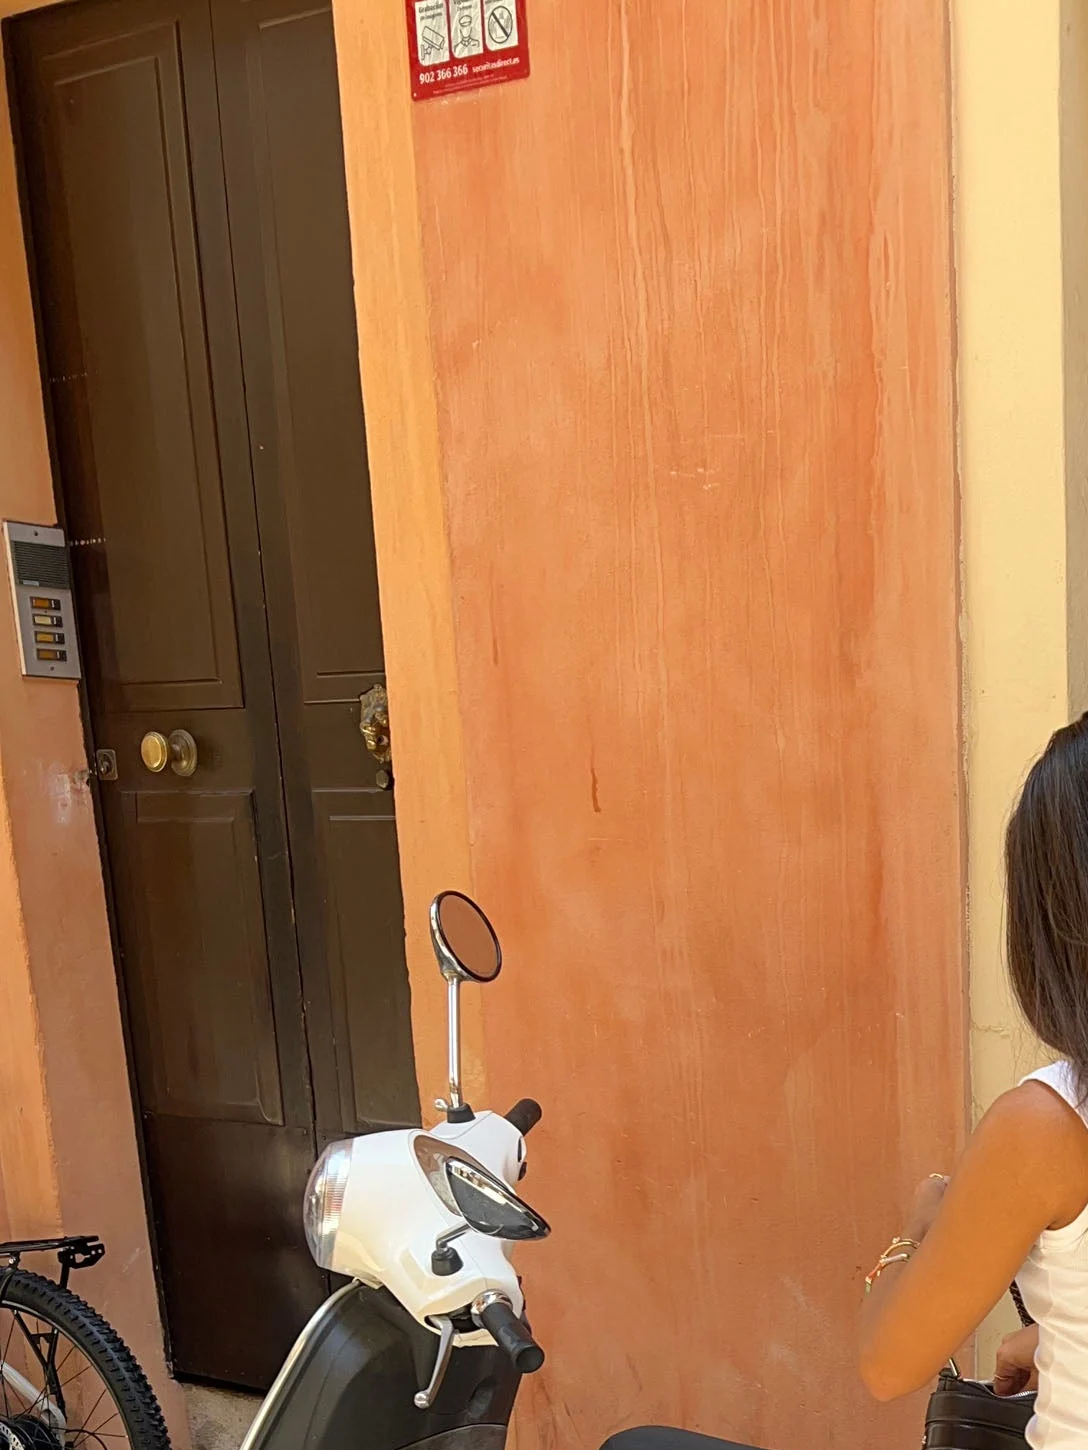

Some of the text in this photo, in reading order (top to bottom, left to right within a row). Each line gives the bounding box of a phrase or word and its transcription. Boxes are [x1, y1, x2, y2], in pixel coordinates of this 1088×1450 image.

[419, 71, 435, 84] 902
[436, 68, 452, 81] 366
[453, 64, 469, 78] 366
